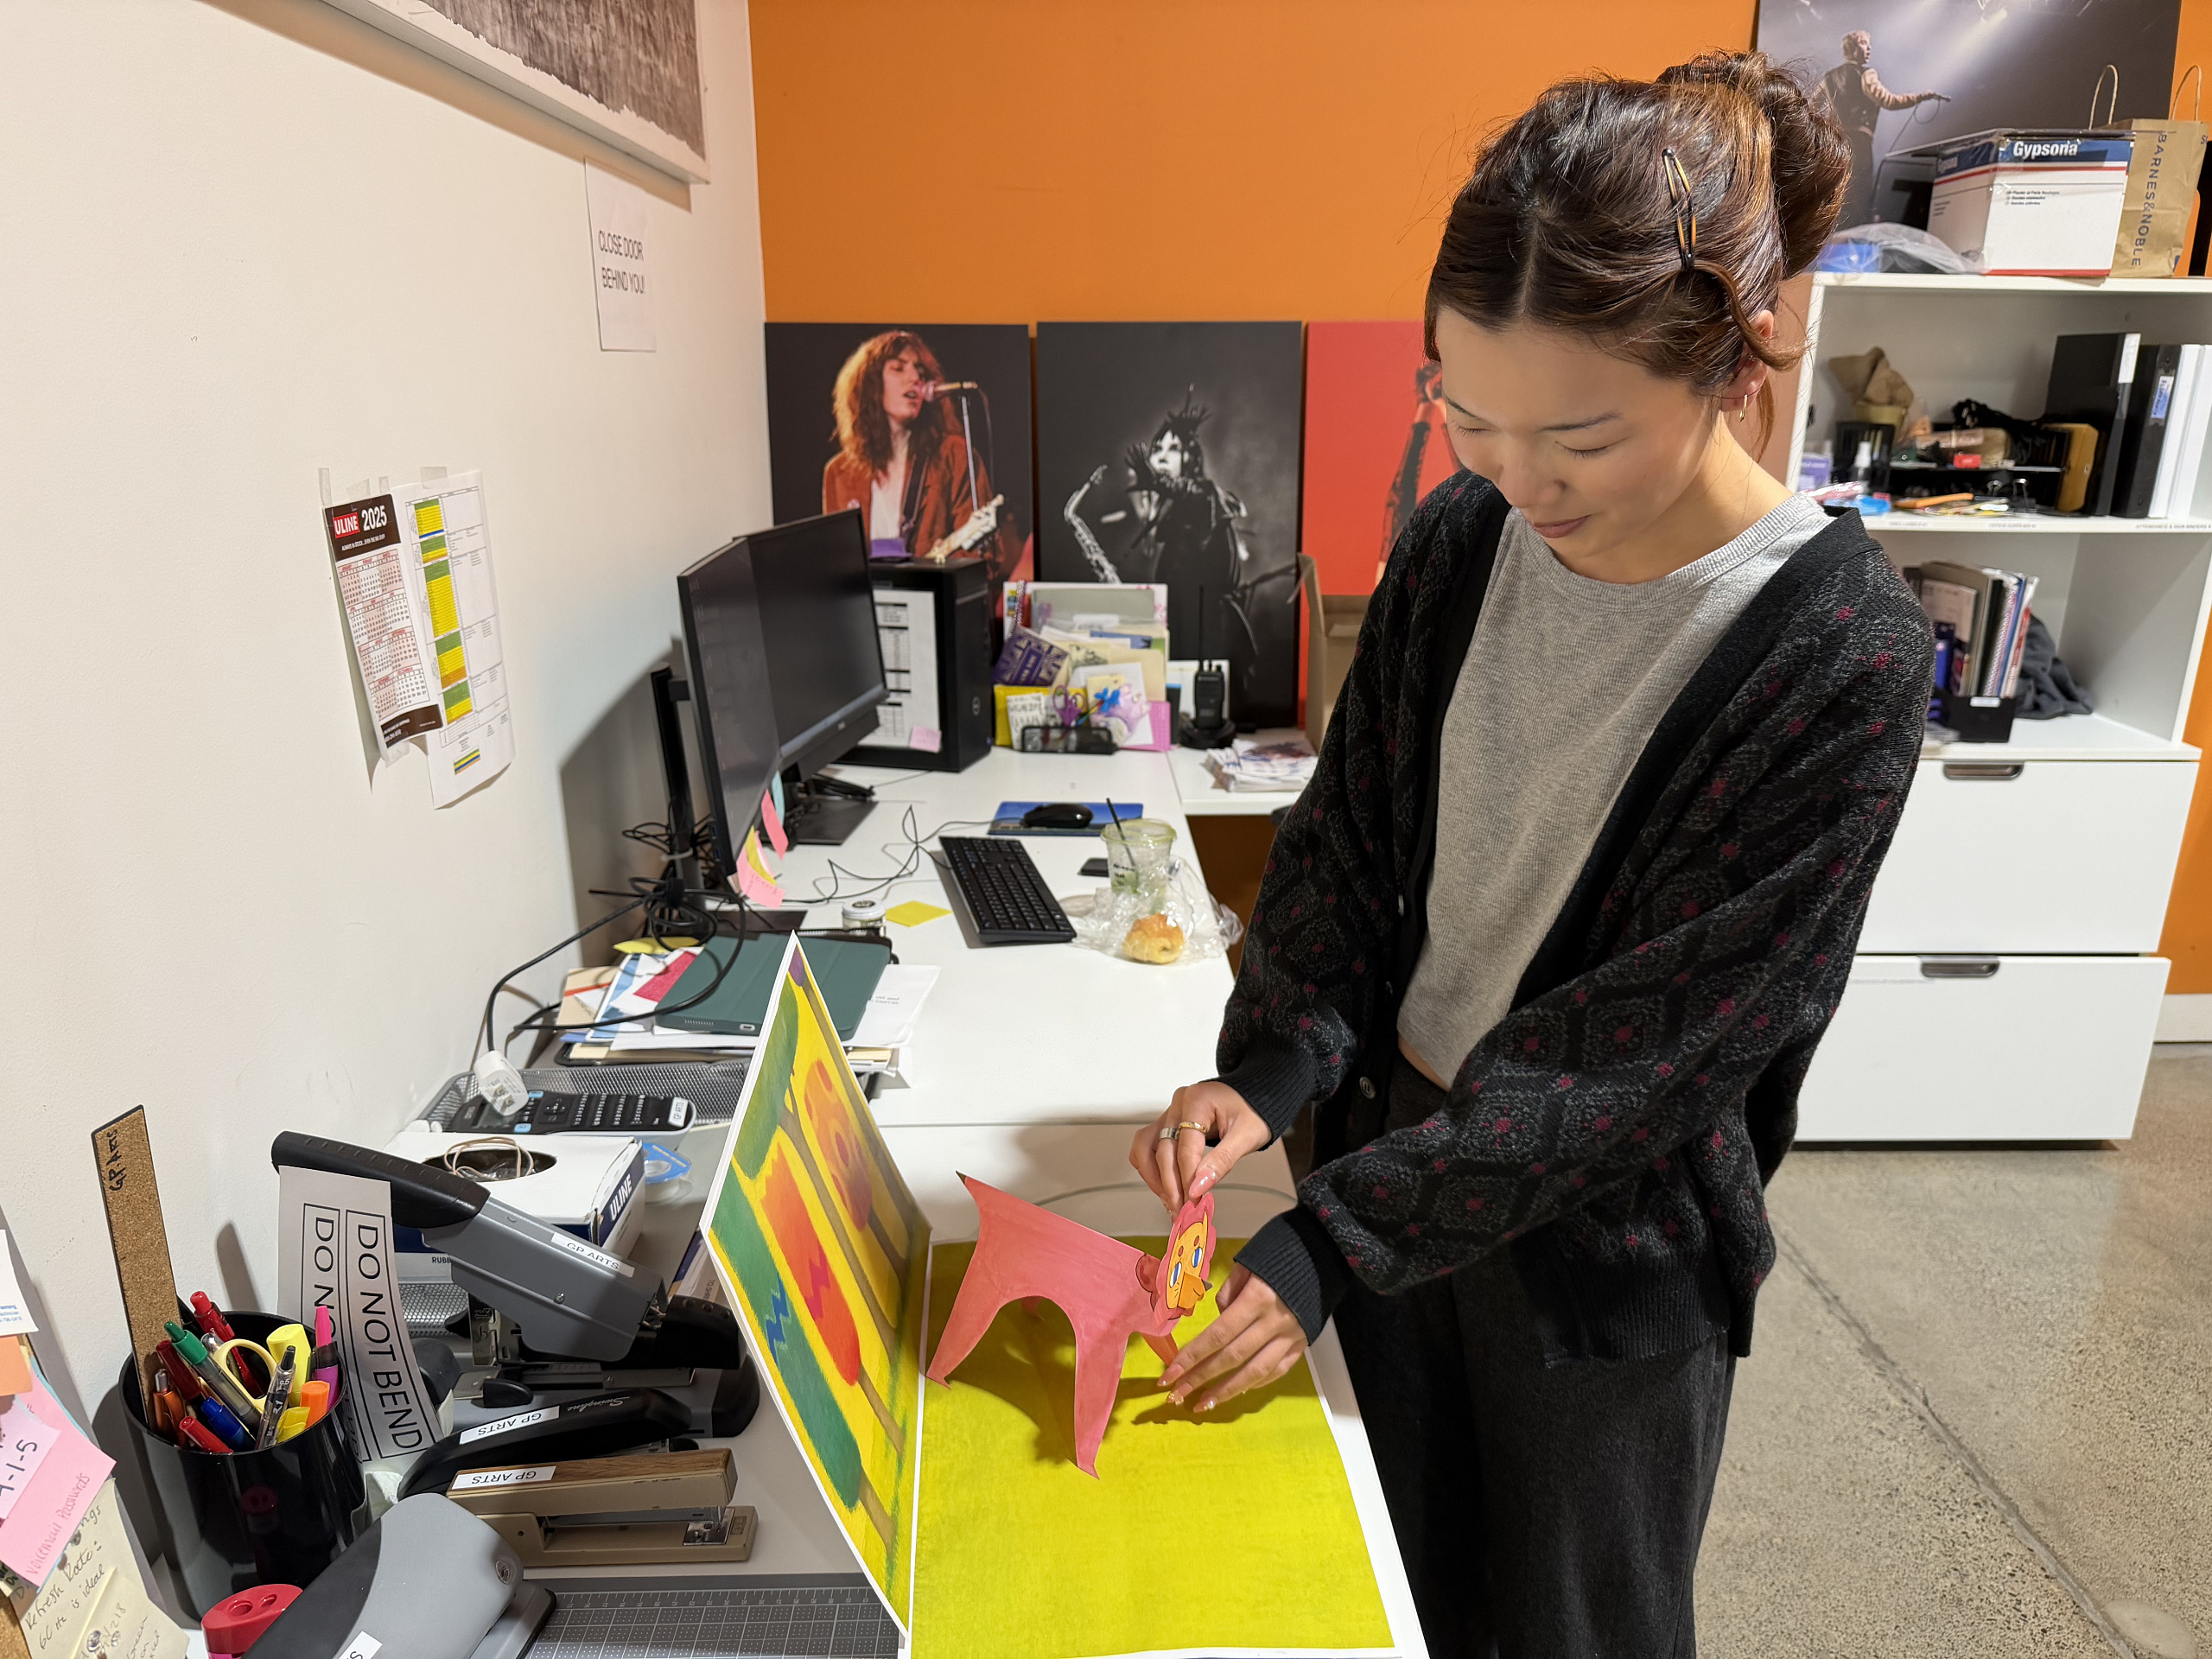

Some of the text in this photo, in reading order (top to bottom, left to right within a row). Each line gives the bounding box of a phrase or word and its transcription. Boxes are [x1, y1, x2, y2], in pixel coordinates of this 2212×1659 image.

[2012, 141, 2078, 160] Gypsona
[598, 230, 644, 261] CLOSE DOOR
[601, 266, 629, 291] BEHIND
[334, 505, 387, 535] ULINE 2025
[609, 1173, 632, 1221] ULINE
[314, 1217, 334, 1272] DO
[567, 1243, 620, 1269] GP ARTS
[358, 1224, 423, 1449] DO NOT BEND
[567, 1396, 631, 1413] Swingline
[478, 1413, 542, 1435] GP ARTS
[471, 1471, 537, 1484] GP ARTS
